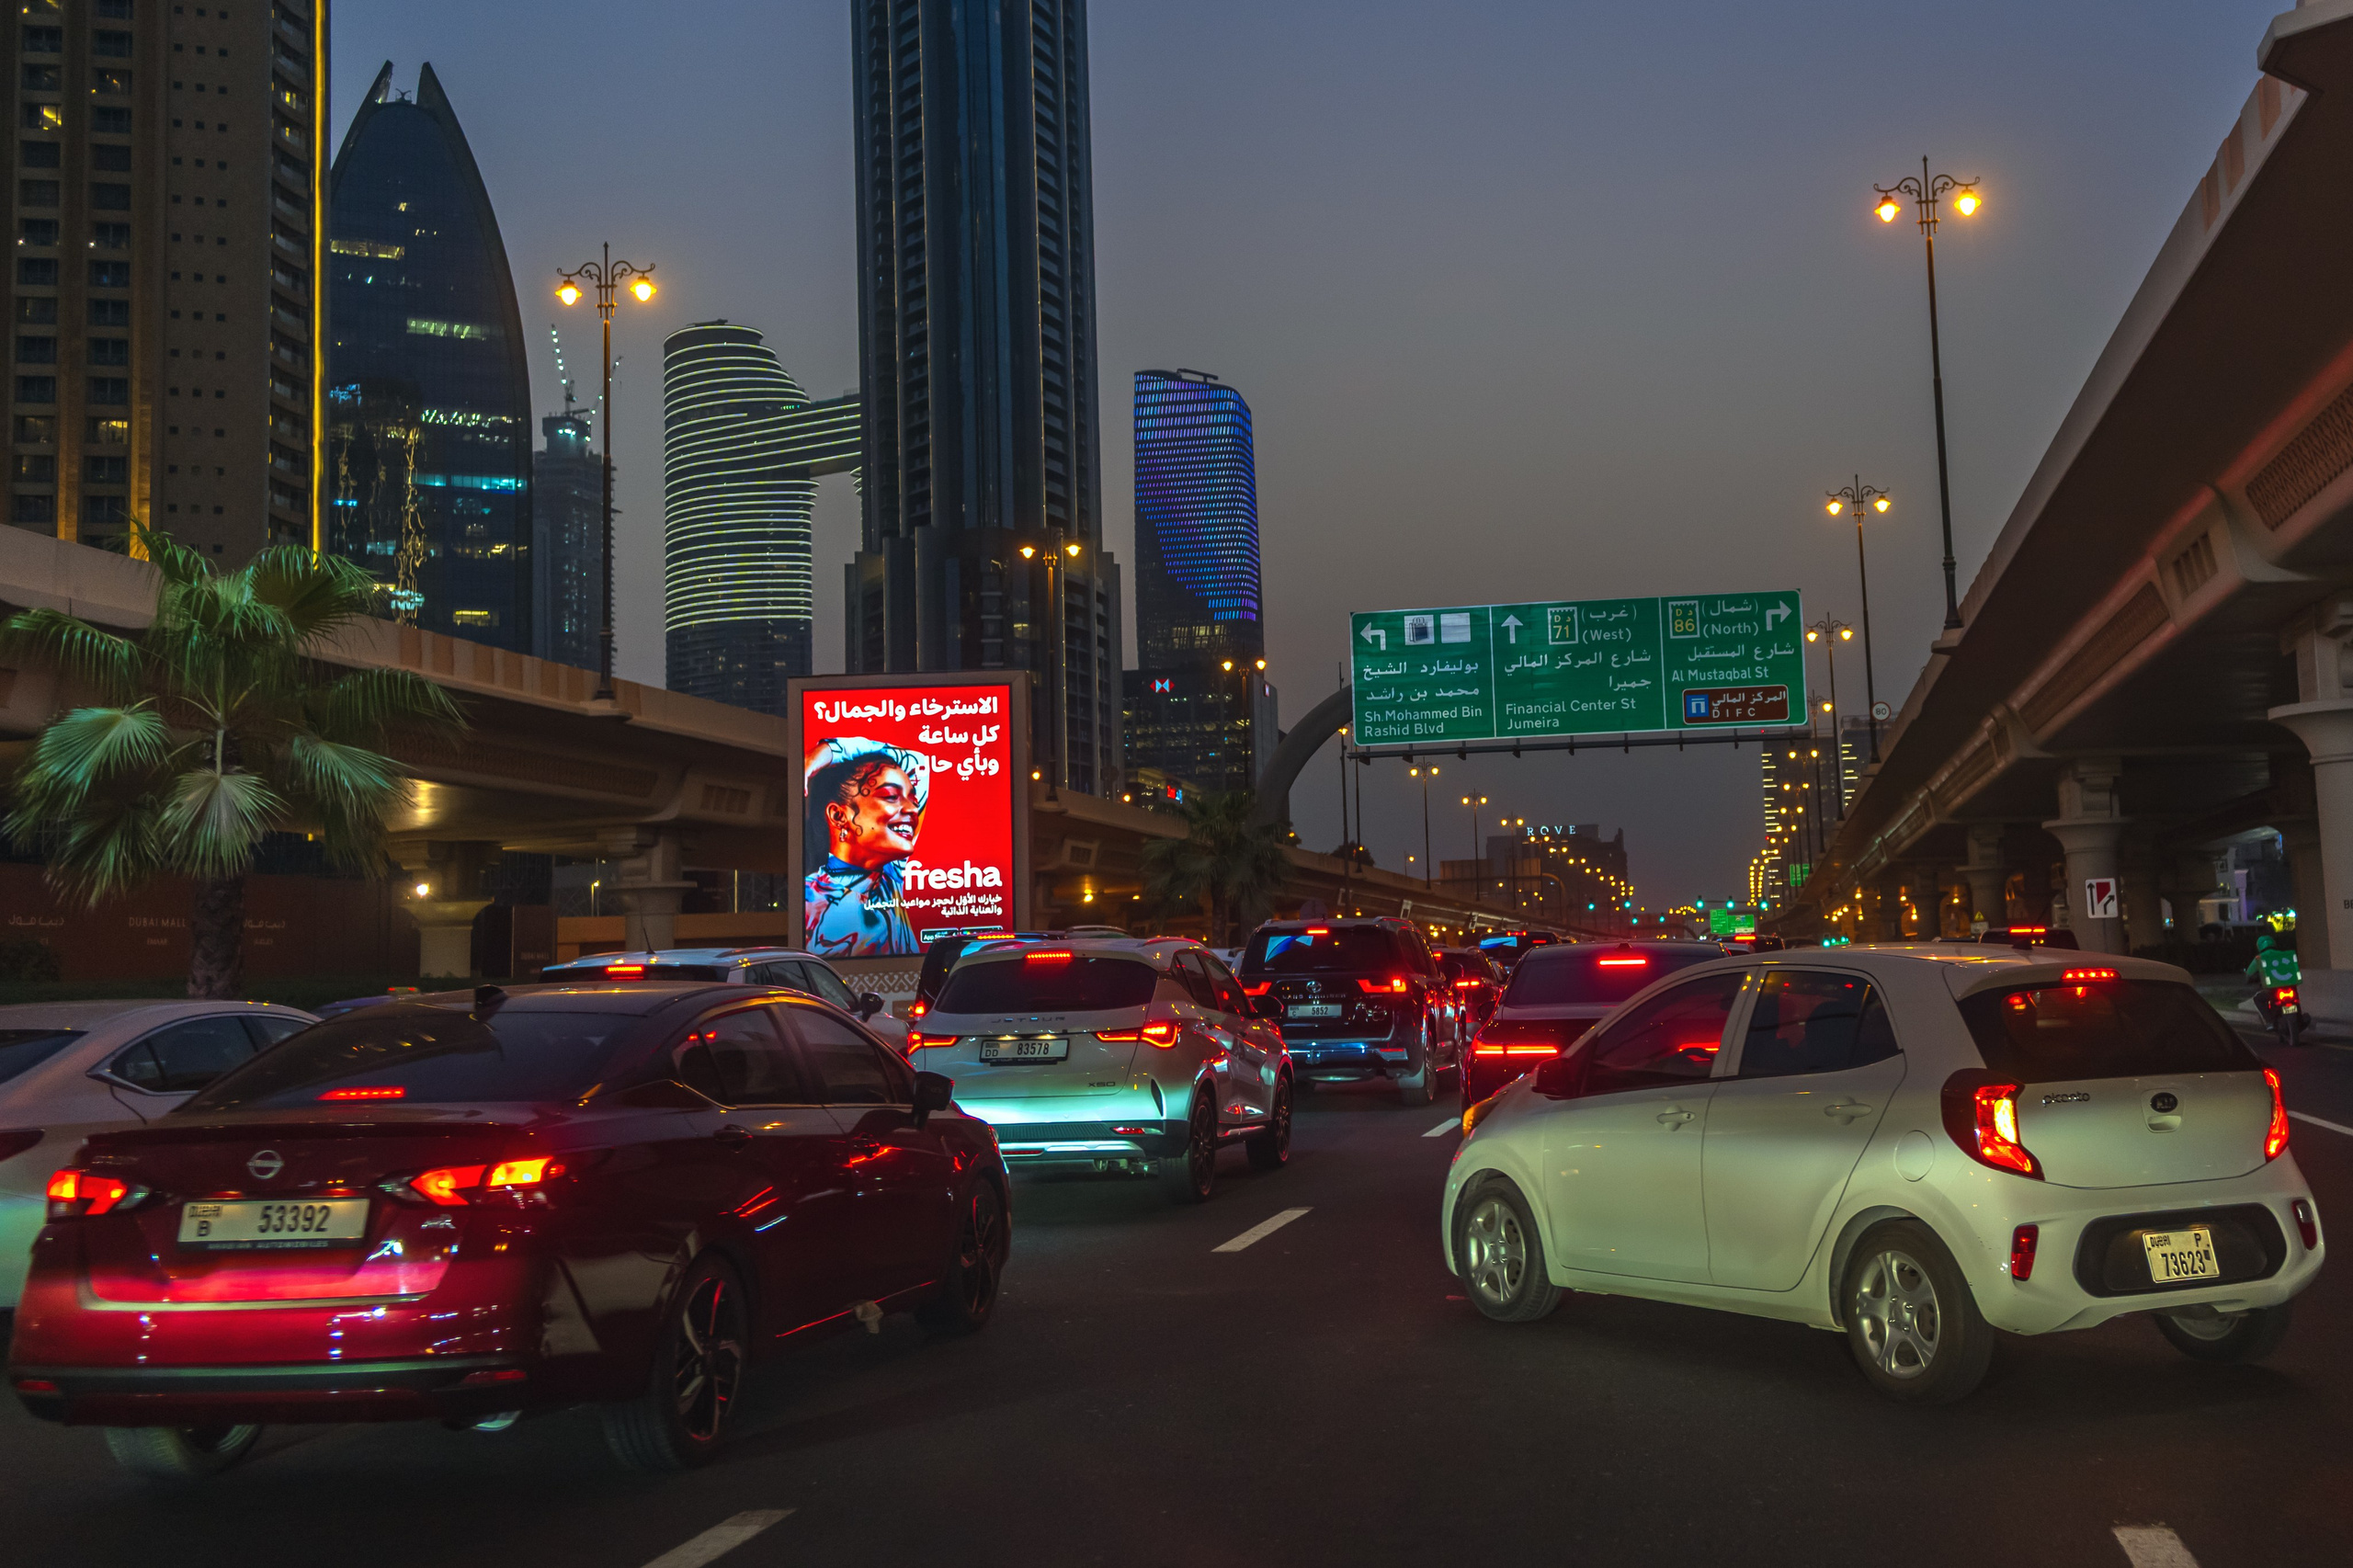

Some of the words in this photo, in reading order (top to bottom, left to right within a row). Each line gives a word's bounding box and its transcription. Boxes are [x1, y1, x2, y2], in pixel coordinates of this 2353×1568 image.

[1553, 615, 1562, 623] D
[1676, 608, 1683, 617] D
[1552, 625, 1570, 639] 71
[1674, 619, 1696, 632] 86
[1703, 621, 1759, 639] (North)
[1582, 627, 1632, 644] (West)
[1554, 651, 1603, 669] المركز
[1610, 649, 1652, 668] شارع
[1688, 643, 1745, 662] المستقبل
[1754, 642, 1795, 661] شارع
[1362, 661, 1407, 681] الشيخ
[1420, 659, 1479, 676] بوليفارد
[1504, 653, 1548, 676] المالي
[1672, 669, 1684, 682] Al
[1688, 666, 1752, 682] Mustaqbal
[1755, 665, 1769, 678] St
[1608, 676, 1652, 691] جميرا
[1366, 687, 1404, 702] راشد
[1409, 688, 1428, 701] بن
[1435, 687, 1480, 699] محمد
[1711, 692, 1745, 710] المالي
[1749, 690, 1787, 705] المركز
[813, 699, 906, 723] والجمال؟
[909, 696, 998, 721] الاسترخاء
[1461, 706, 1483, 718] Bin
[1506, 701, 1567, 715] Financial
[1570, 699, 1617, 711] Center
[1620, 698, 1636, 709] St
[1875, 708, 1887, 716] 80
[1365, 723, 1410, 737] Rashid
[1414, 722, 1445, 735] Blvd
[1507, 717, 1560, 730] Jumeira
[917, 724, 969, 744] ساعة
[972, 724, 1000, 746] كل
[957, 746, 1000, 781] وبأي
[1526, 824, 1576, 836] ROVE
[903, 859, 1003, 891] fresha
[129, 916, 159, 927] DUBAI
[161, 917, 187, 928] MALL
[1311, 1006, 1329, 1016] 5852
[1017, 1042, 1050, 1056] 83578
[2041, 1091, 2091, 1108] picanto
[257, 1205, 331, 1233] 53392
[197, 1221, 210, 1237] B
[2193, 1233, 2201, 1247] P
[2161, 1250, 2206, 1277] 73623
